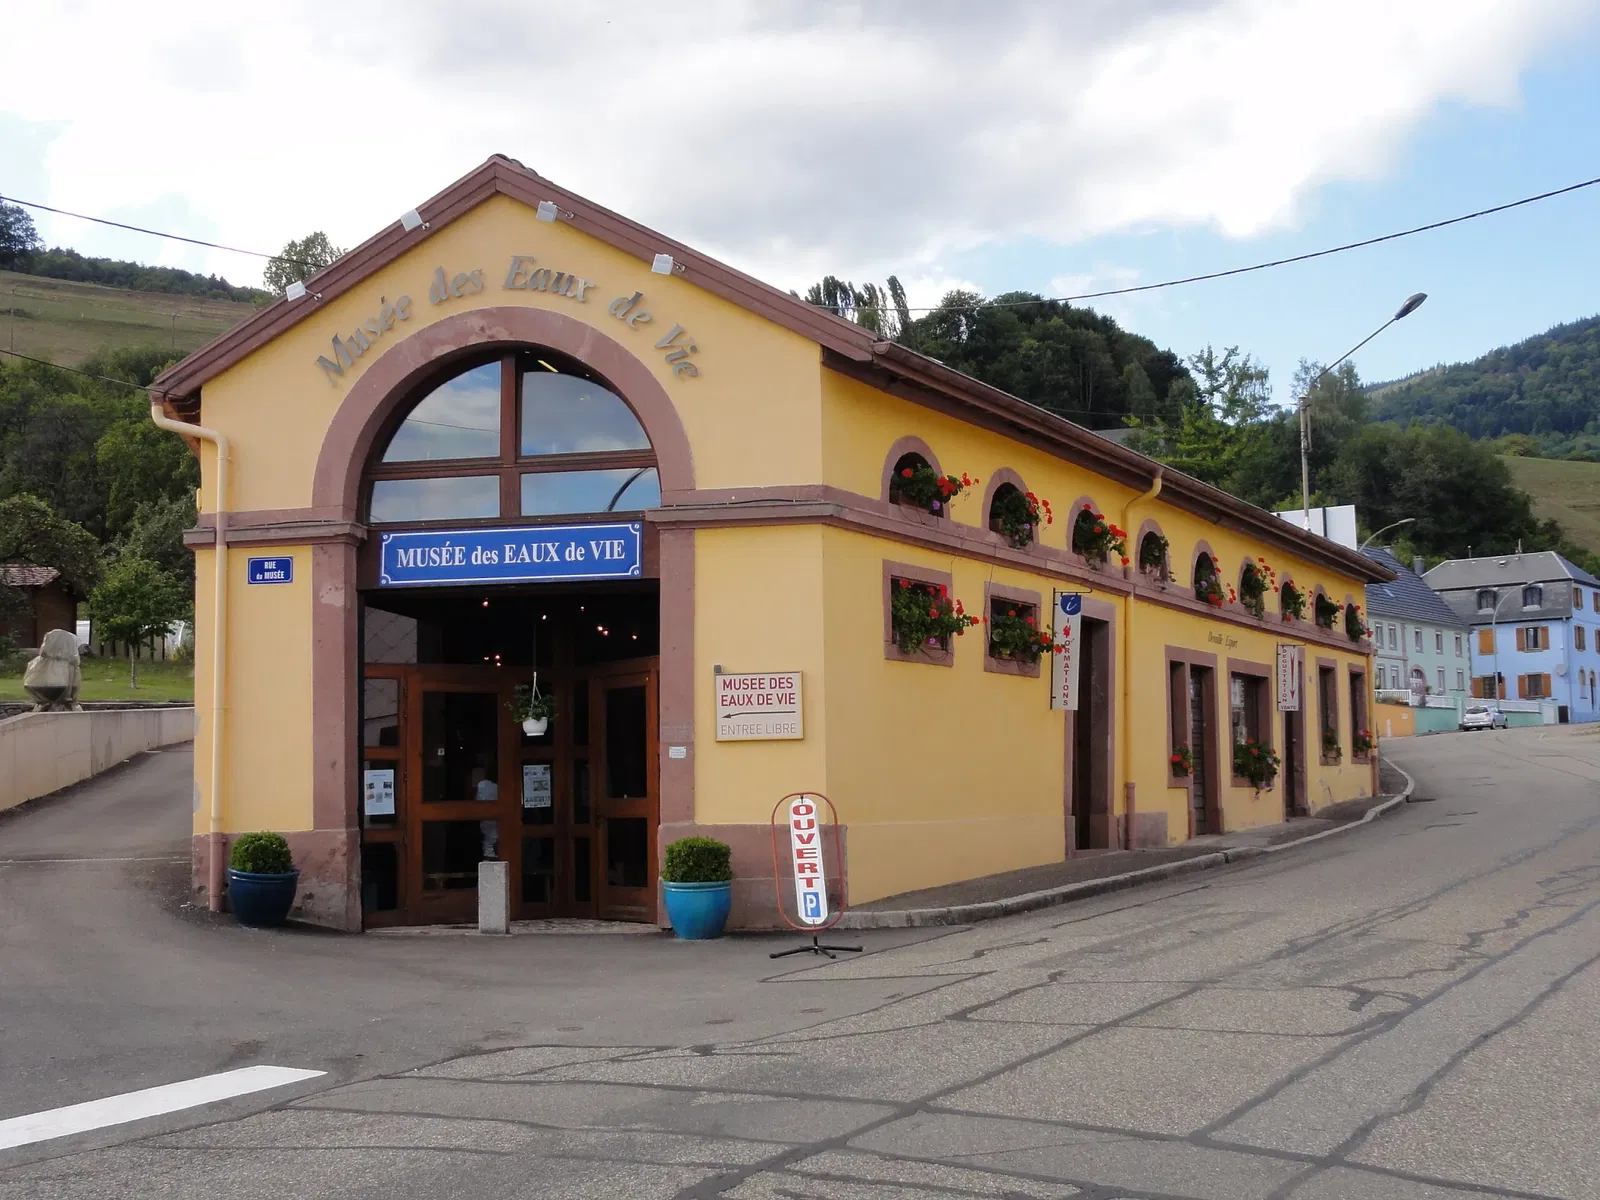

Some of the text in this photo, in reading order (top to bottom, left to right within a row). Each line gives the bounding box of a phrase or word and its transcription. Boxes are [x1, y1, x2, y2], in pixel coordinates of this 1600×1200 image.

[314, 255, 699, 389] Musée des Eaux de Vie
[396, 539, 626, 568] MUSÉE des EAUX de VIE
[256, 569, 285, 580] du MUSÉE
[264, 561, 277, 569] RUE
[1062, 617, 1071, 706] IORMATIONS
[722, 677, 794, 691] MUSEE DES
[721, 692, 796, 707] EAUX DE VIE
[721, 722, 797, 736] ENTREE LIBRE
[792, 804, 820, 888] OUVERT
[806, 893, 817, 916] P
